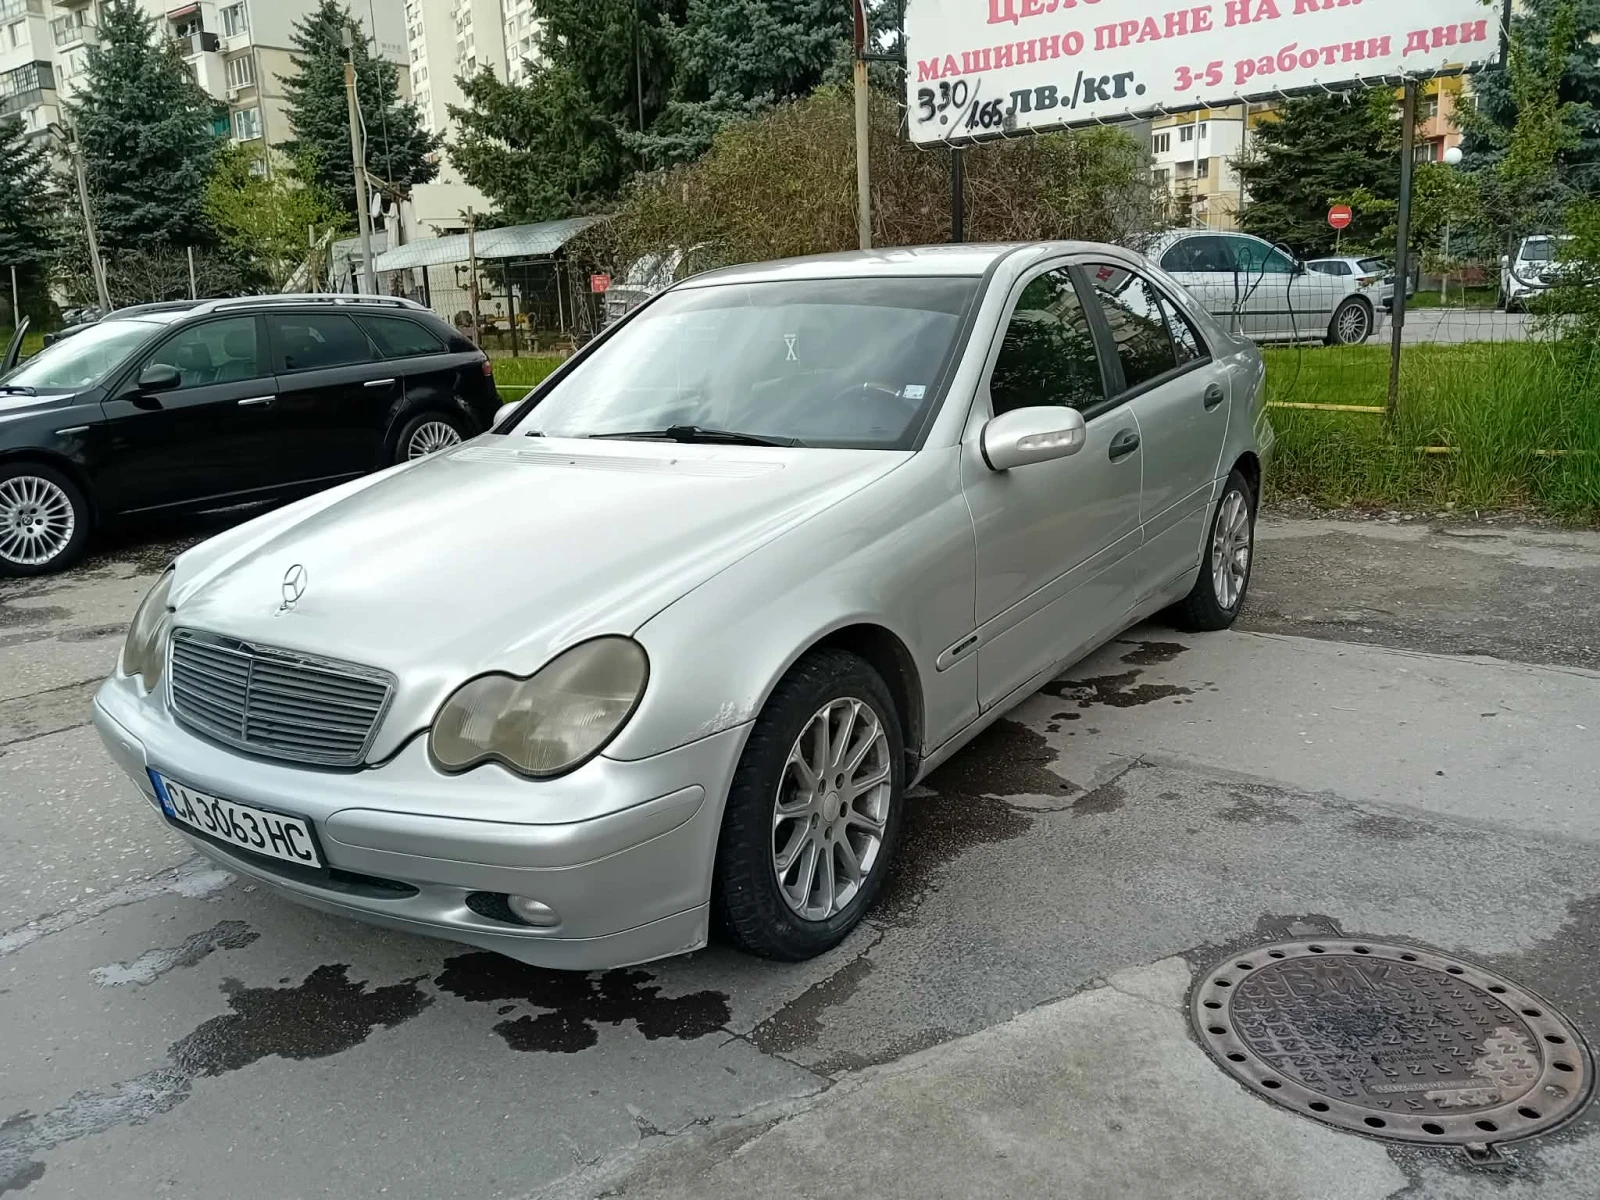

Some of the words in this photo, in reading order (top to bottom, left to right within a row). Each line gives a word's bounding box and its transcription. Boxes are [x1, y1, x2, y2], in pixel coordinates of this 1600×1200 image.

[917, 31, 1084, 82] МАШИННО
[1093, 5, 1213, 51] ПРАНЕ
[1225, 0, 1282, 27] НА
[987, 0, 1102, 26] ЦЕ
[1173, 61, 1224, 91] 3-5
[1234, 35, 1391, 85] работни
[1402, 20, 1487, 57] дни
